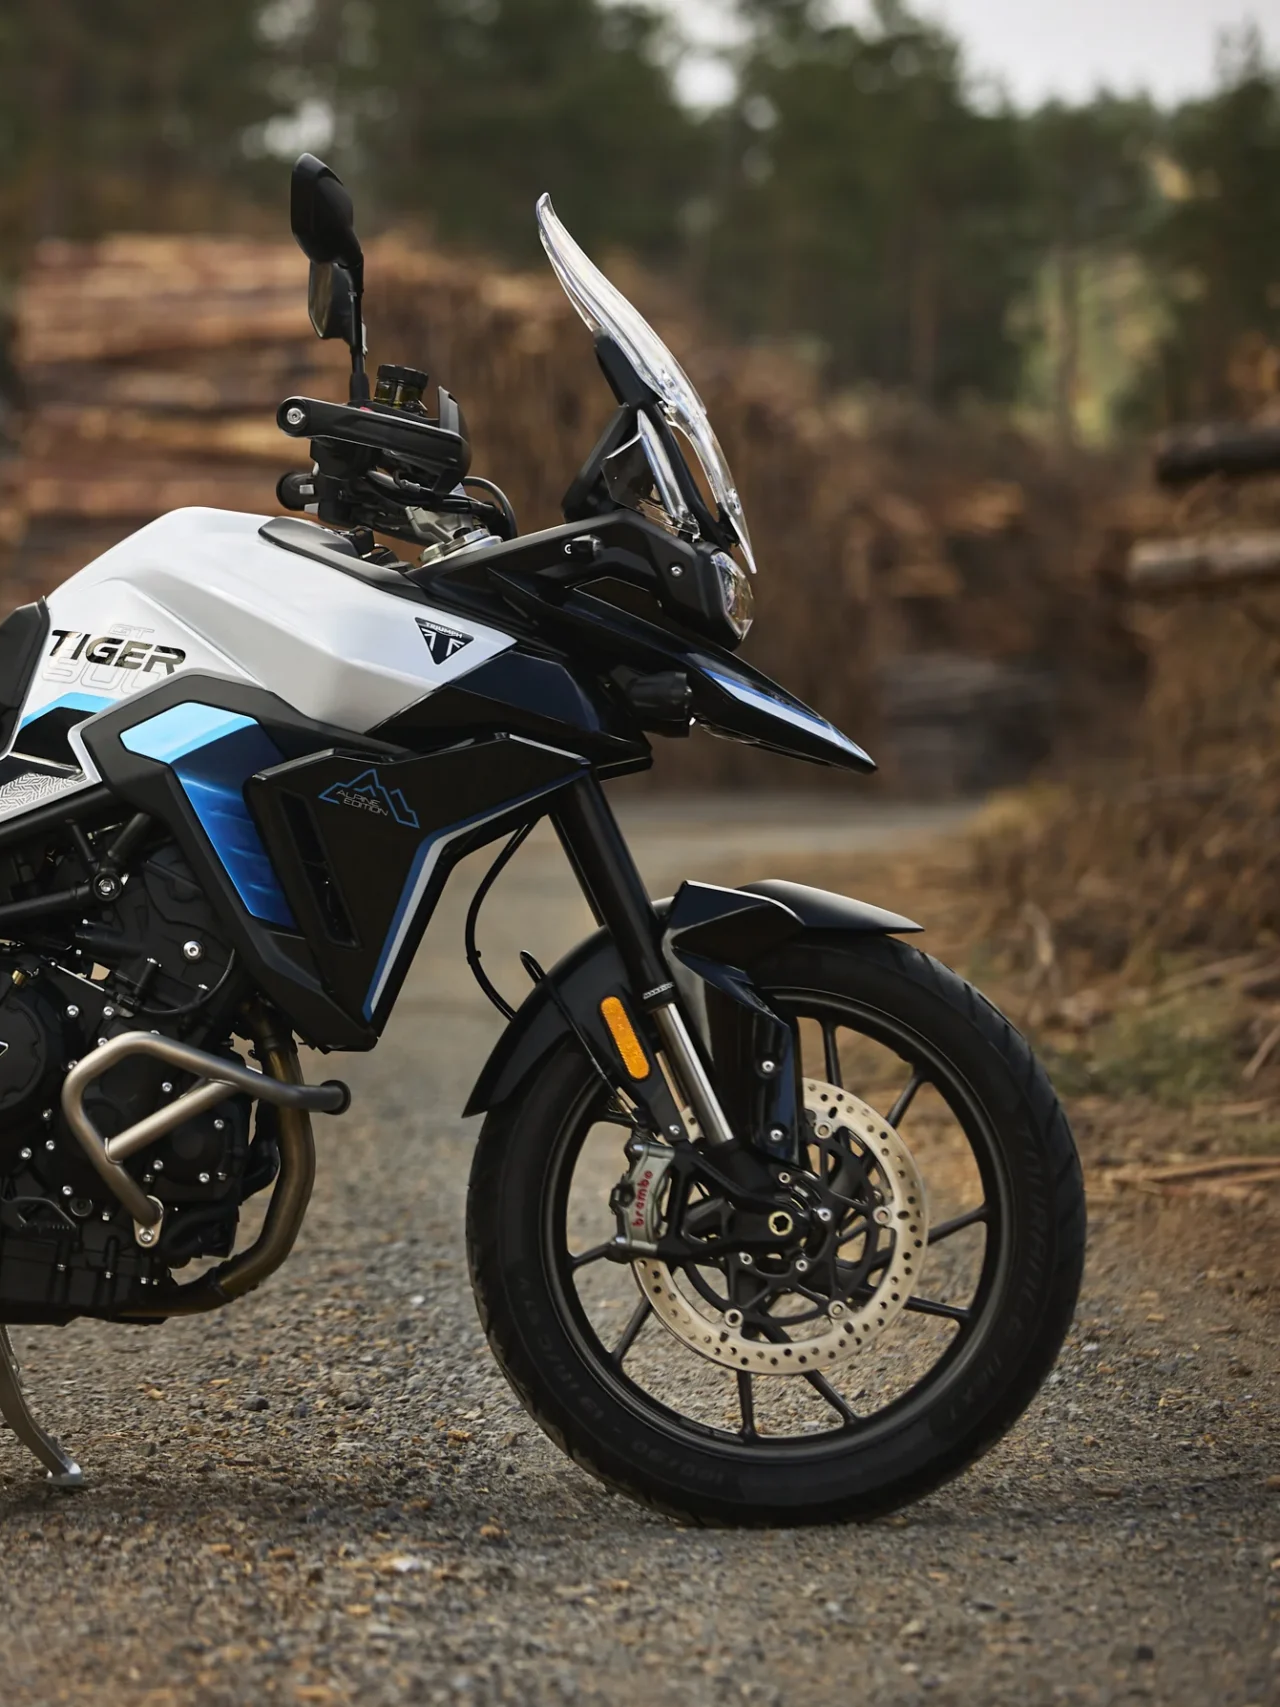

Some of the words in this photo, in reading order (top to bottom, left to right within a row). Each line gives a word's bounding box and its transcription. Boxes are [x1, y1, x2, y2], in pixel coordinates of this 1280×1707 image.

[108, 623, 155, 639] GT
[425, 622, 463, 639] TRIUMPH
[49, 629, 187, 675] TIGER
[336, 789, 381, 806] ALPINE
[343, 797, 389, 816] EDITION
[632, 1170, 654, 1228] brembo
